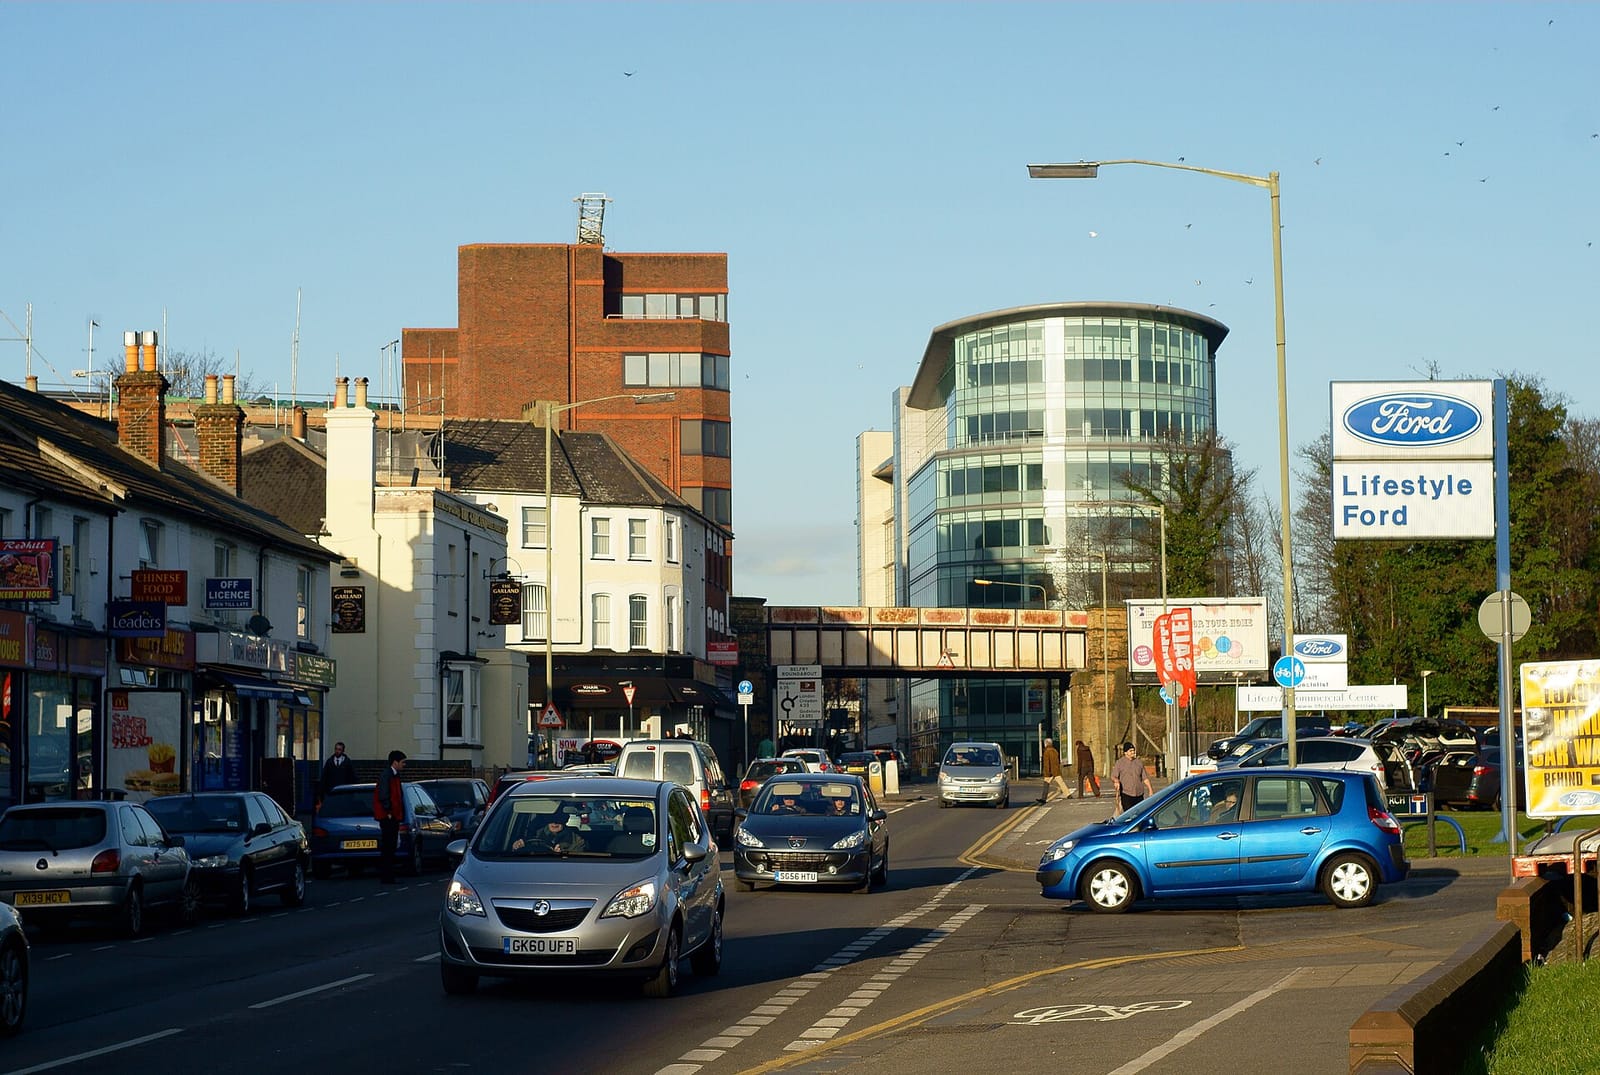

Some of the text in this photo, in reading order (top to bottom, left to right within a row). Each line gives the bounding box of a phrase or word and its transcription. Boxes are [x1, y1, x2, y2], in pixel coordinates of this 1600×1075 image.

[1371, 400, 1454, 434] Ford
[1342, 475, 1473, 500] Lifestyle
[1343, 505, 1408, 526] Ford
[3, 541, 46, 550] Redhill
[135, 573, 181, 583] CHINESE
[220, 580, 239, 589] OFF
[0, 590, 51, 599] KEBAB HOUSE
[143, 584, 174, 593] FOOD
[208, 590, 251, 599] LICENCE
[112, 615, 161, 629] Leaders
[1302, 640, 1333, 654] Ford
[1531, 739, 1569, 767] CAR
[1543, 771, 1583, 788] BEHIND
[780, 872, 816, 881] SG56 HTU
[512, 940, 574, 953] GK60 UFB
